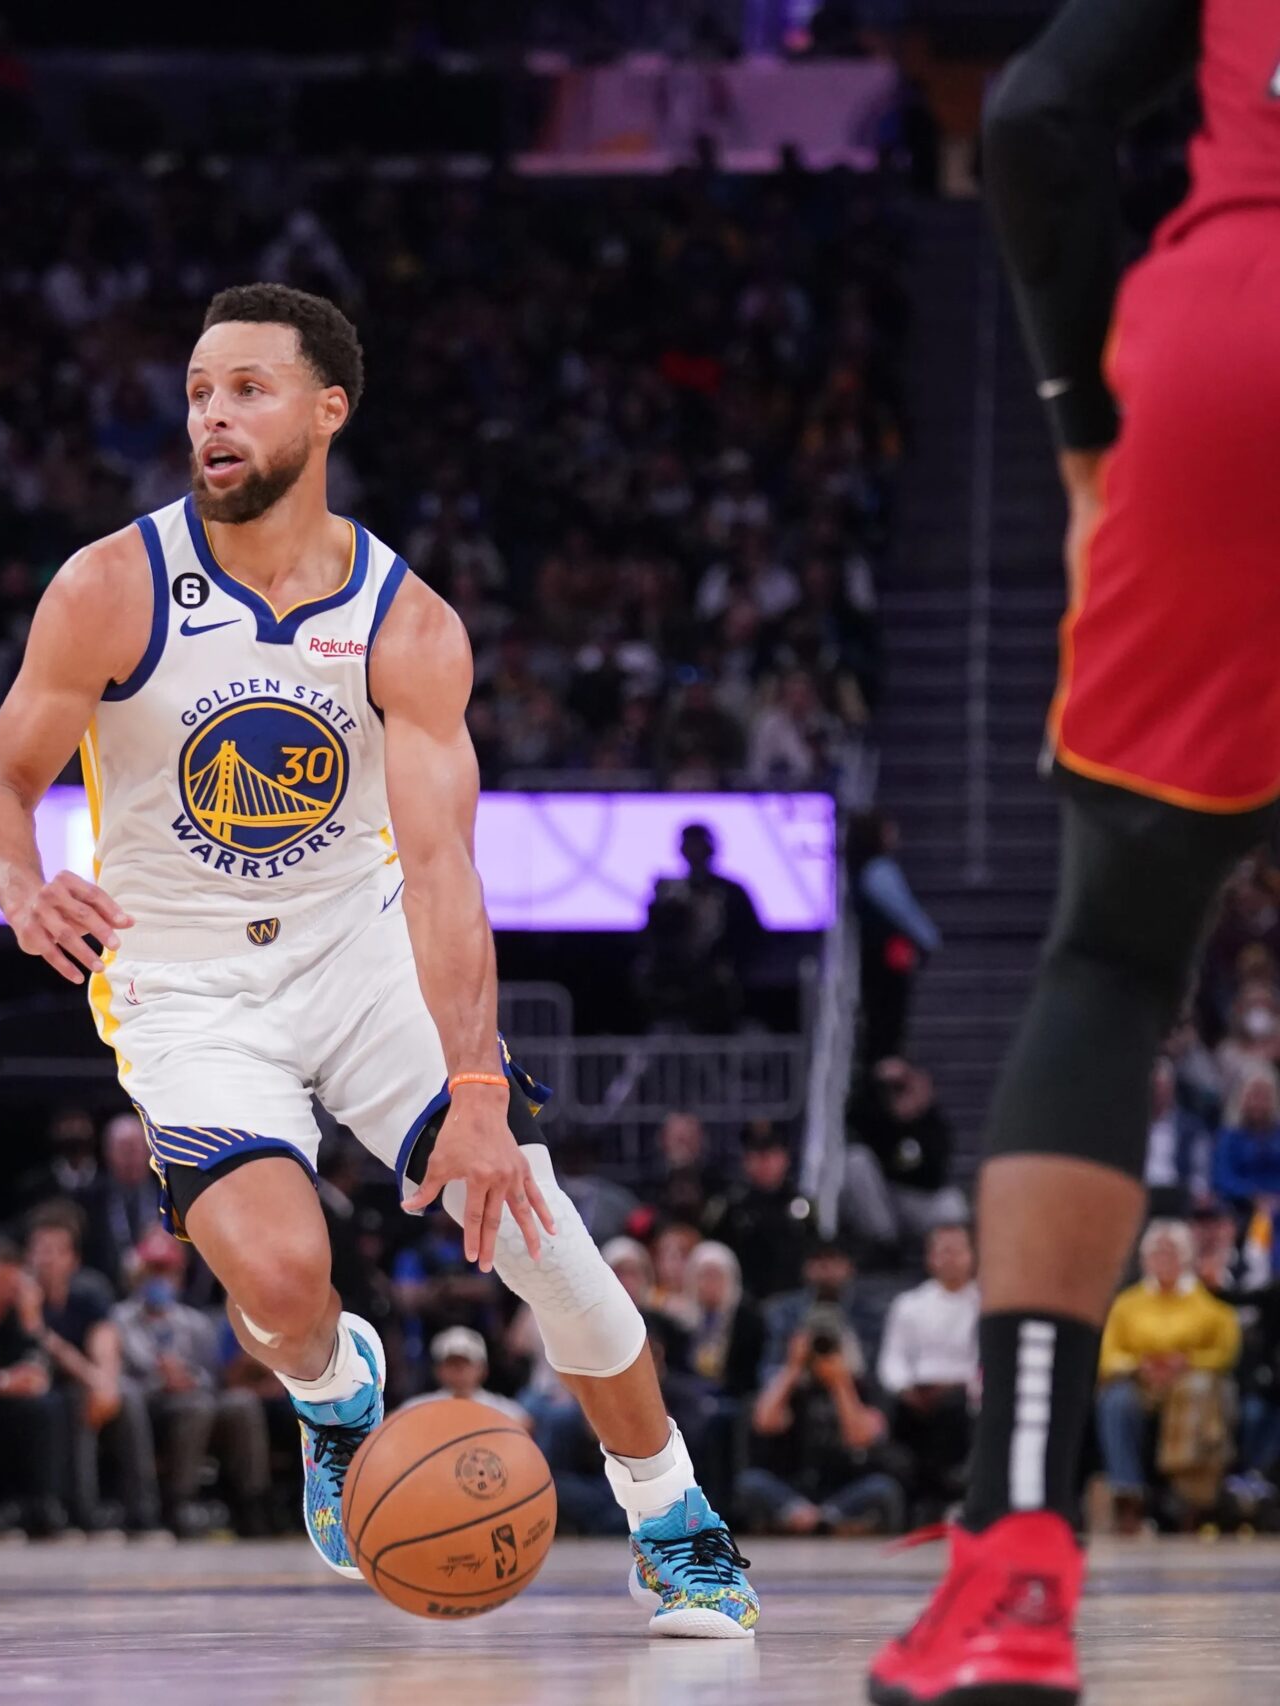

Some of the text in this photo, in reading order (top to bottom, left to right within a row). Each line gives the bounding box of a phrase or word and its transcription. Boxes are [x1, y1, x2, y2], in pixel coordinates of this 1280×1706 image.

[180, 577, 201, 605] 6
[181, 678, 357, 734] GOLDEN STATE
[277, 746, 334, 786] 30
[171, 813, 346, 879] WARRIORS
[249, 919, 278, 944] W
